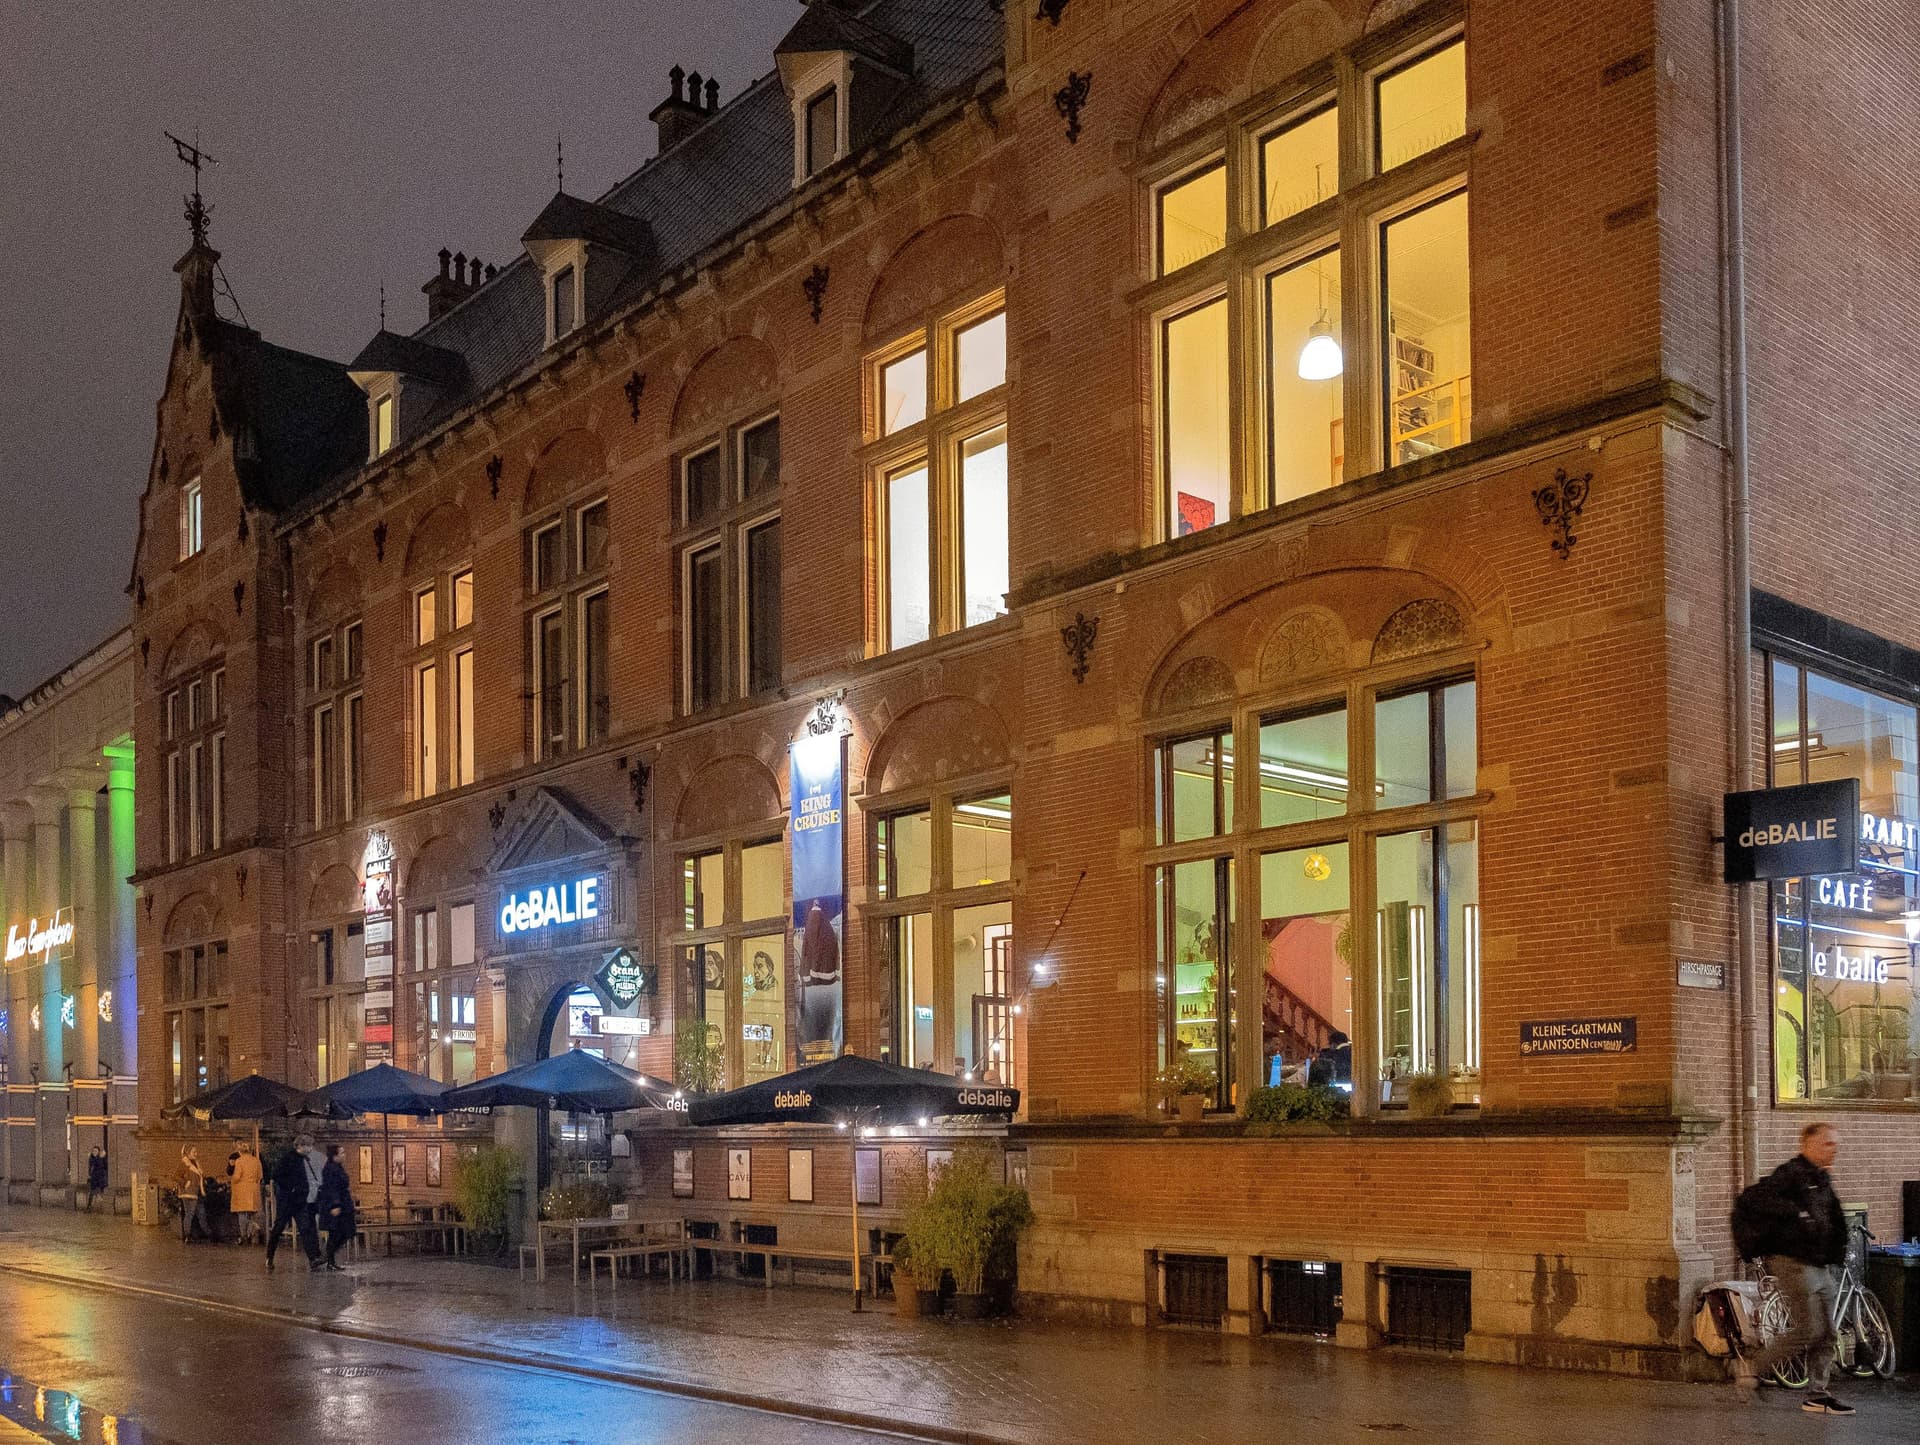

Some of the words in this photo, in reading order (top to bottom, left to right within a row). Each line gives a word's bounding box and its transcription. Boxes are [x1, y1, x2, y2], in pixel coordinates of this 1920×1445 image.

[800, 793, 832, 814] KING
[794, 809, 841, 832] CRUISE
[1739, 818, 1838, 847] deBALIE
[501, 877, 598, 933] deBALIE
[1819, 877, 1874, 912] CAFÉ
[611, 963, 640, 976] Brand
[1836, 946, 1889, 984] balie
[1532, 1022, 1622, 1037] KLEINE-GARTMAN
[1532, 1038, 1588, 1051] PLANTSOEN
[774, 1089, 812, 1108] debalie
[958, 1088, 1012, 1107] debalie
